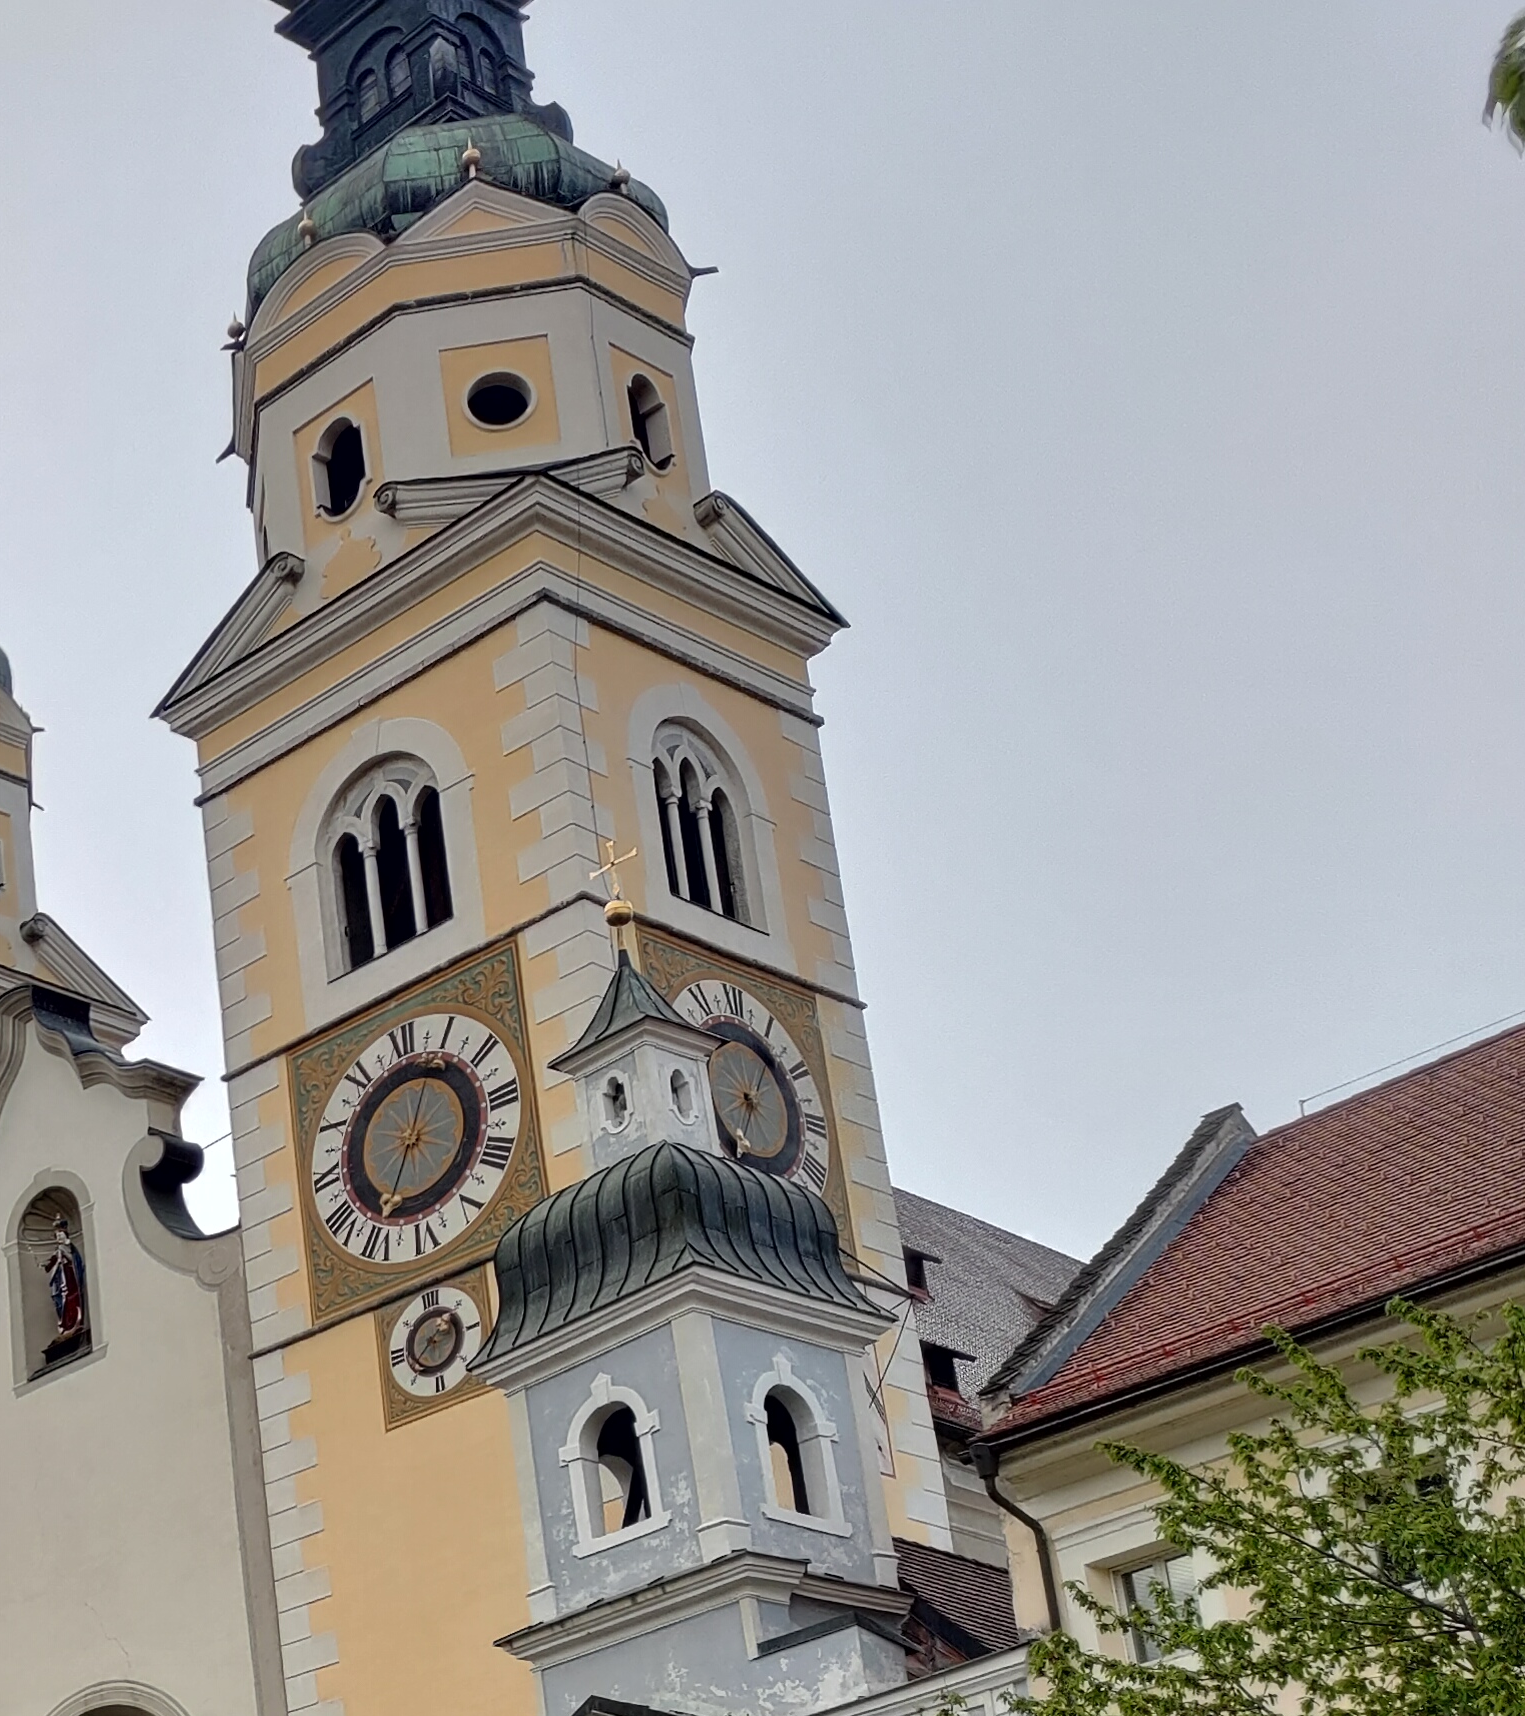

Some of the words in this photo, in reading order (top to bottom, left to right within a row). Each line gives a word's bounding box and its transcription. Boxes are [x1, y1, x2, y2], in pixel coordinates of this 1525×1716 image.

[386, 1020, 416, 1067] XII
[439, 1016, 456, 1049] I
[470, 1033, 500, 1068] II
[344, 1060, 373, 1098] XI
[789, 1060, 810, 1080] II
[487, 1076, 519, 1111] III
[318, 1117, 349, 1136] X
[805, 1113, 827, 1139] III
[314, 1161, 340, 1194] IX
[325, 1199, 357, 1247] VIII
[459, 1194, 487, 1225] V
[360, 1224, 391, 1261] VII
[414, 1221, 441, 1256] VI
[390, 1348, 405, 1367] III
[435, 1375, 446, 1393] II
